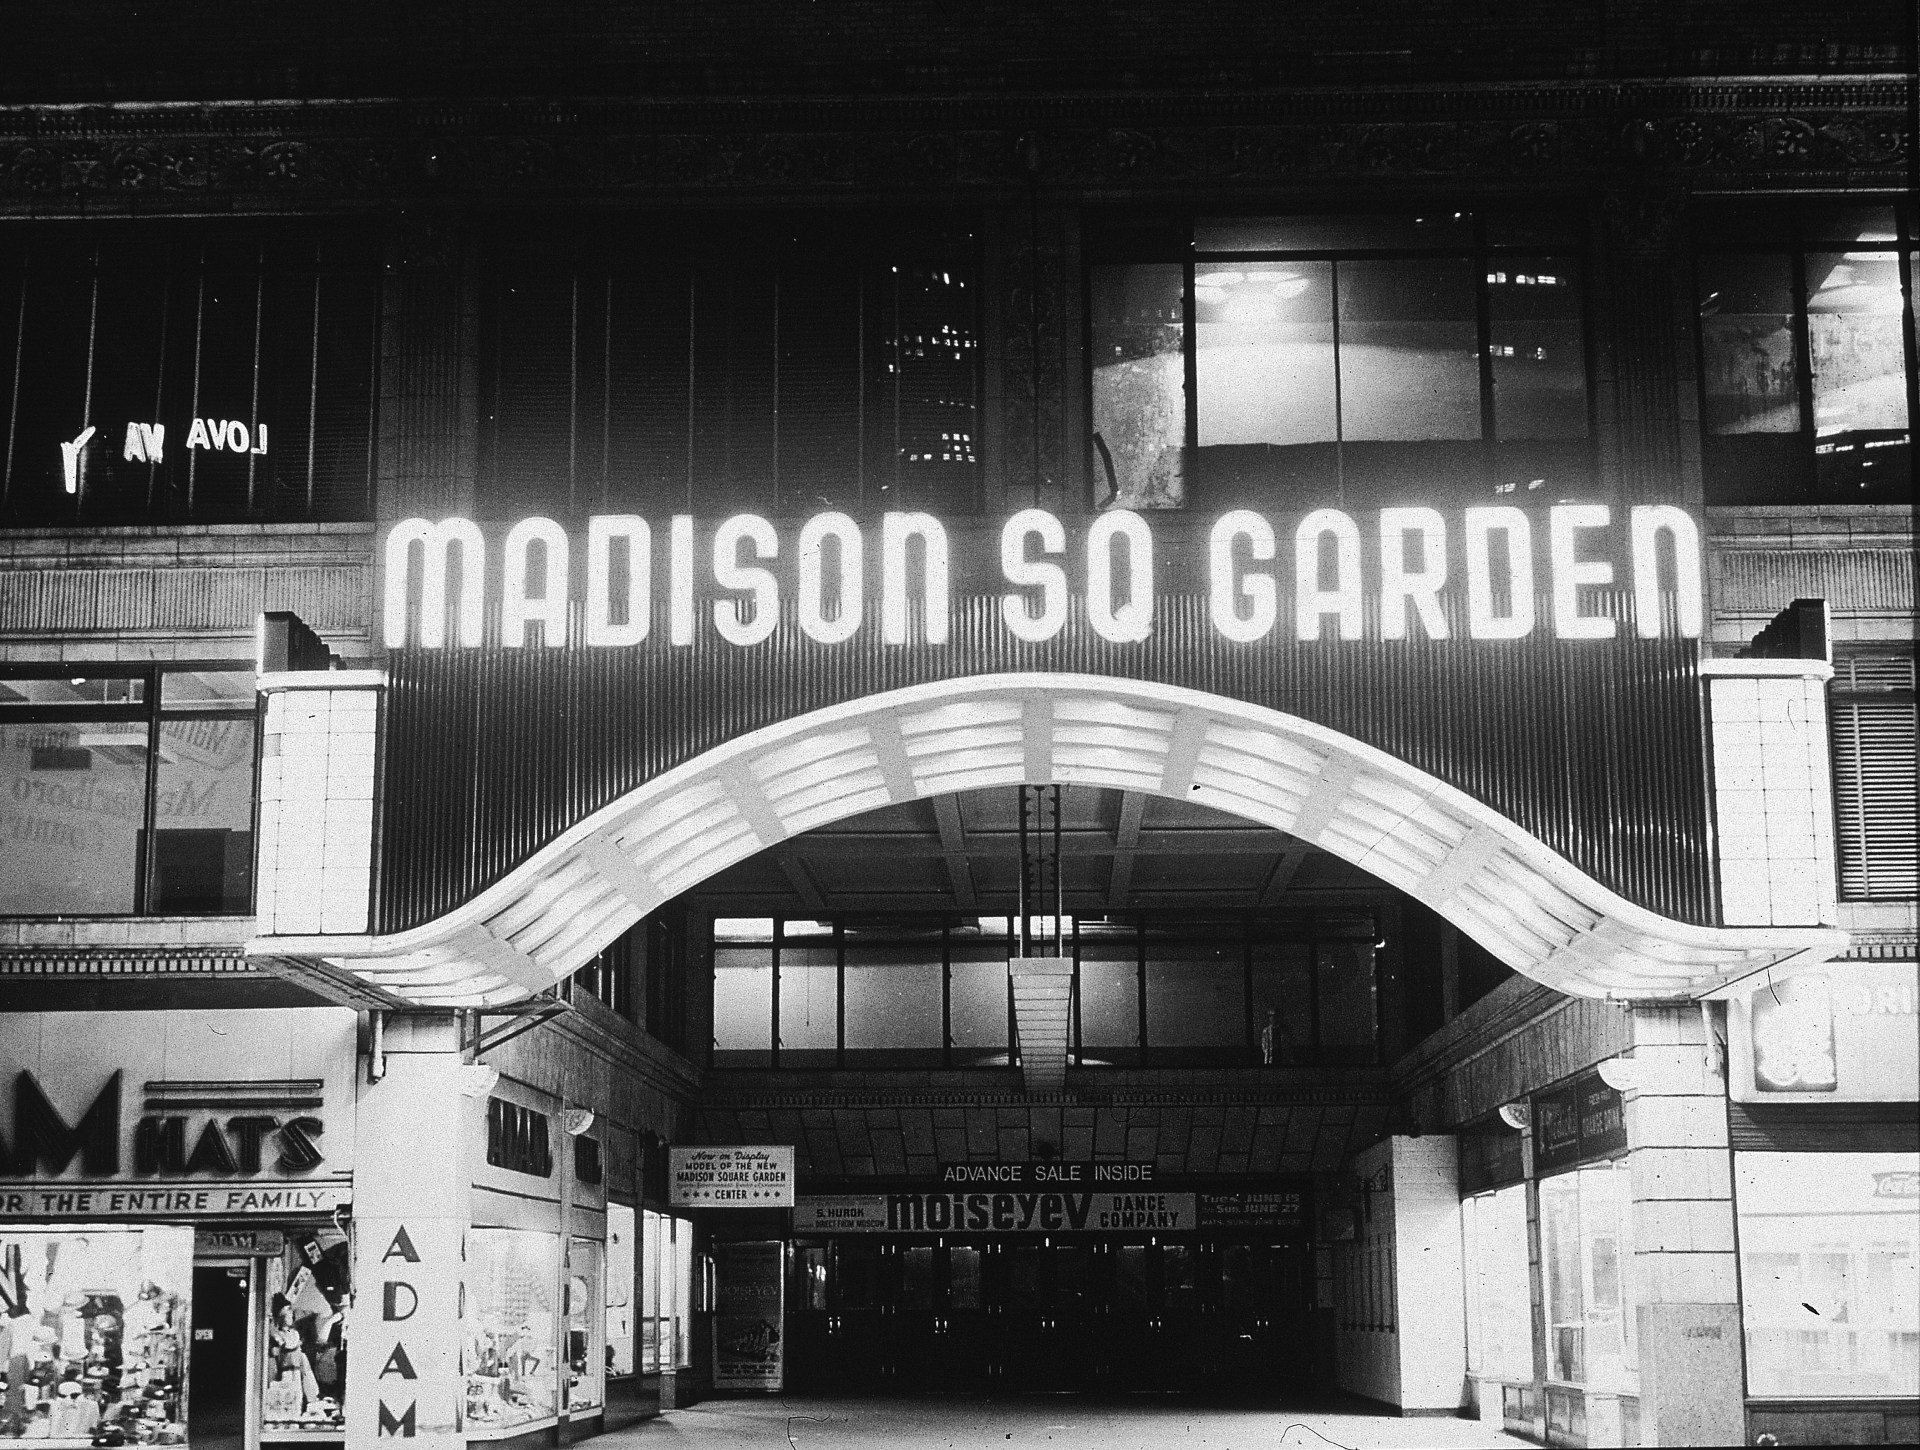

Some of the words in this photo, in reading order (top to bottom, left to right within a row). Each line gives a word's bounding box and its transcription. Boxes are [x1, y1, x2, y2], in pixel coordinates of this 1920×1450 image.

[383, 510, 949, 648] MADISON
[1001, 507, 1155, 645] SQ
[1208, 504, 1703, 644] GARDEN
[136, 1115, 325, 1174] HATS
[692, 1151, 716, 1160] Now
[734, 1151, 770, 1162] Display
[685, 1162, 717, 1170] MODEL
[720, 1162, 732, 1170] OF
[736, 1162, 752, 1170] THE
[757, 1162, 778, 1170] NEW
[677, 1172, 715, 1182] MADISON
[717, 1172, 749, 1182] SQUARE
[753, 1172, 786, 1182] GARDEN
[944, 1165, 1022, 1182] ADVANCE
[1035, 1165, 1081, 1182] SALE
[1094, 1165, 1152, 1181] INSIDE
[41, 1194, 92, 1212] THE
[111, 1192, 209, 1211] ENTIRE
[225, 1190, 326, 1210] FAMILY
[715, 1190, 747, 1200] CENTER
[1244, 1193, 1282, 1203] JUNE
[1113, 1195, 1166, 1212] DANCE
[1243, 1204, 1278, 1214] JUNE
[1281, 1204, 1300, 1214] 27
[828, 1208, 865, 1218] HUROK
[1100, 1211, 1179, 1229] COMPANY
[378, 1224, 422, 1438] ADAM
